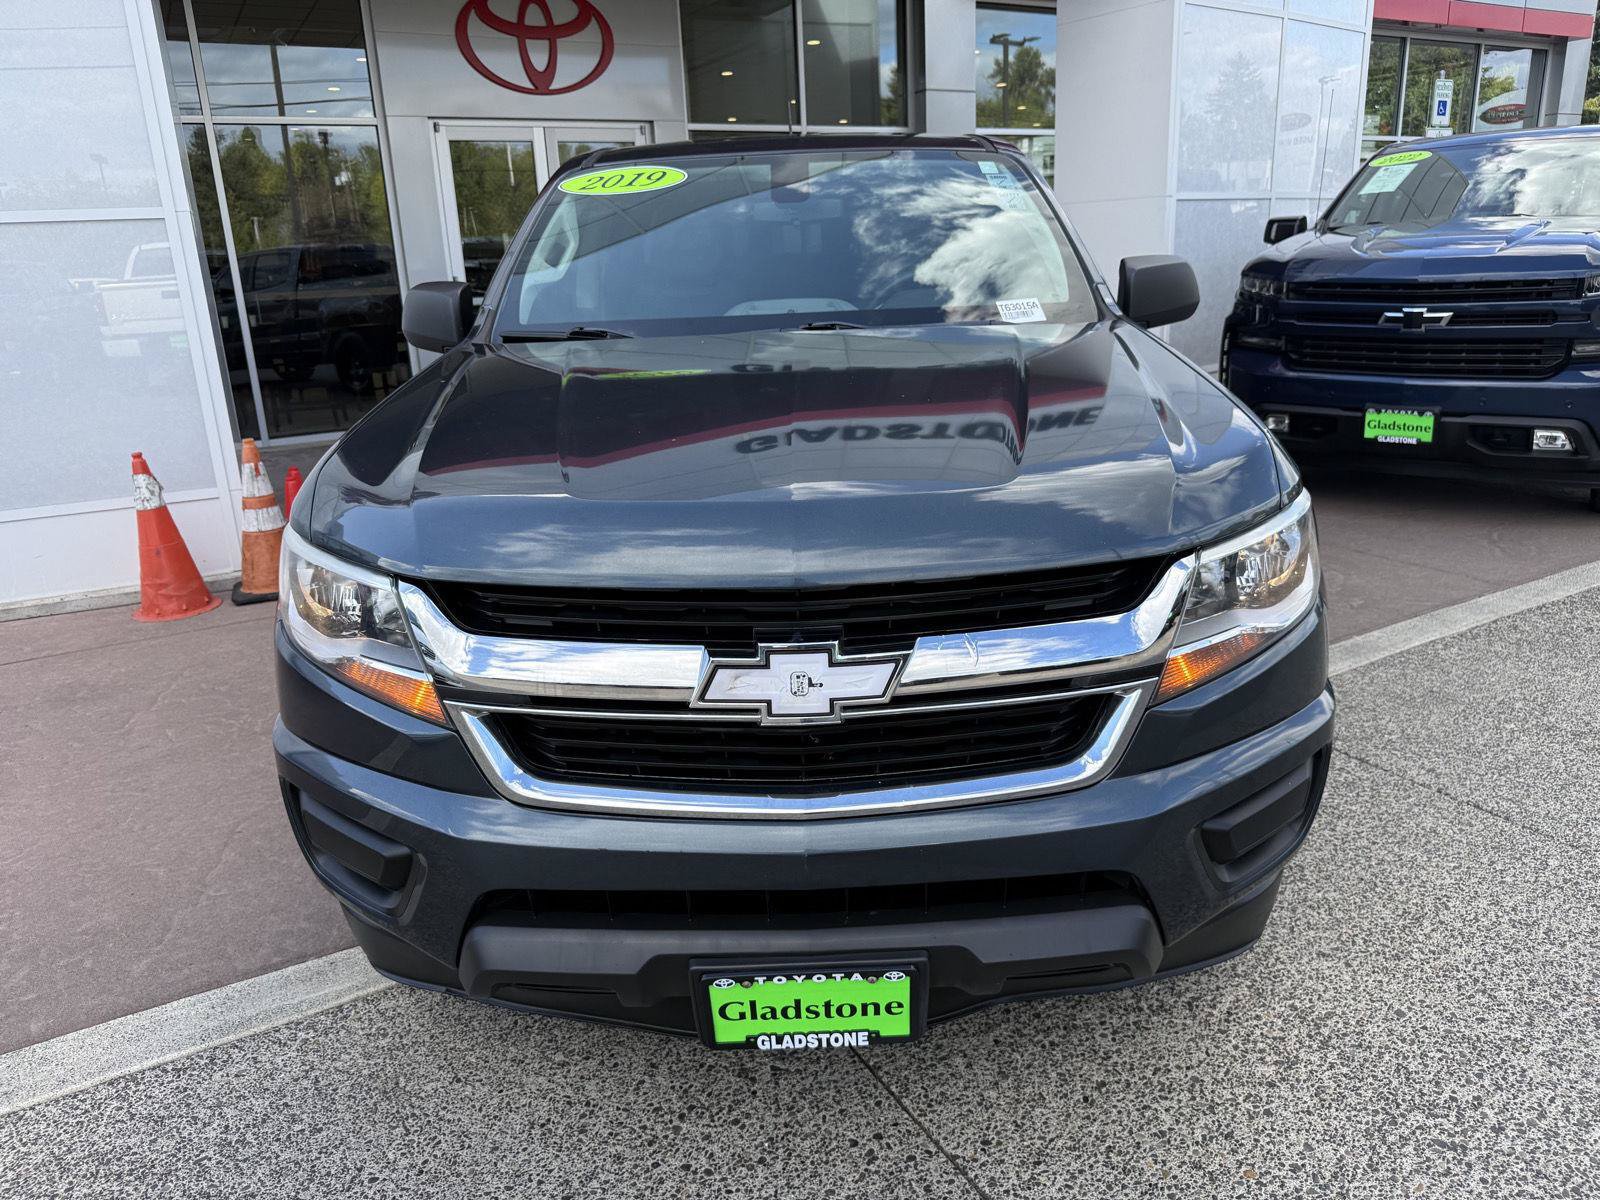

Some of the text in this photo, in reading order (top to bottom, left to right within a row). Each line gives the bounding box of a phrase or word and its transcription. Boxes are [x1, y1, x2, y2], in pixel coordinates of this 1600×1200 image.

[578, 170, 667, 190] 2019
[998, 301, 1039, 313] T63015A
[1381, 408, 1419, 416] TOYOTA
[1367, 419, 1431, 433] Gladstone
[1377, 435, 1418, 445] GLADSTONE
[754, 972, 864, 985] TOYOTA
[718, 998, 904, 1021] Gladstone
[756, 1031, 869, 1050] GLADSTONE
